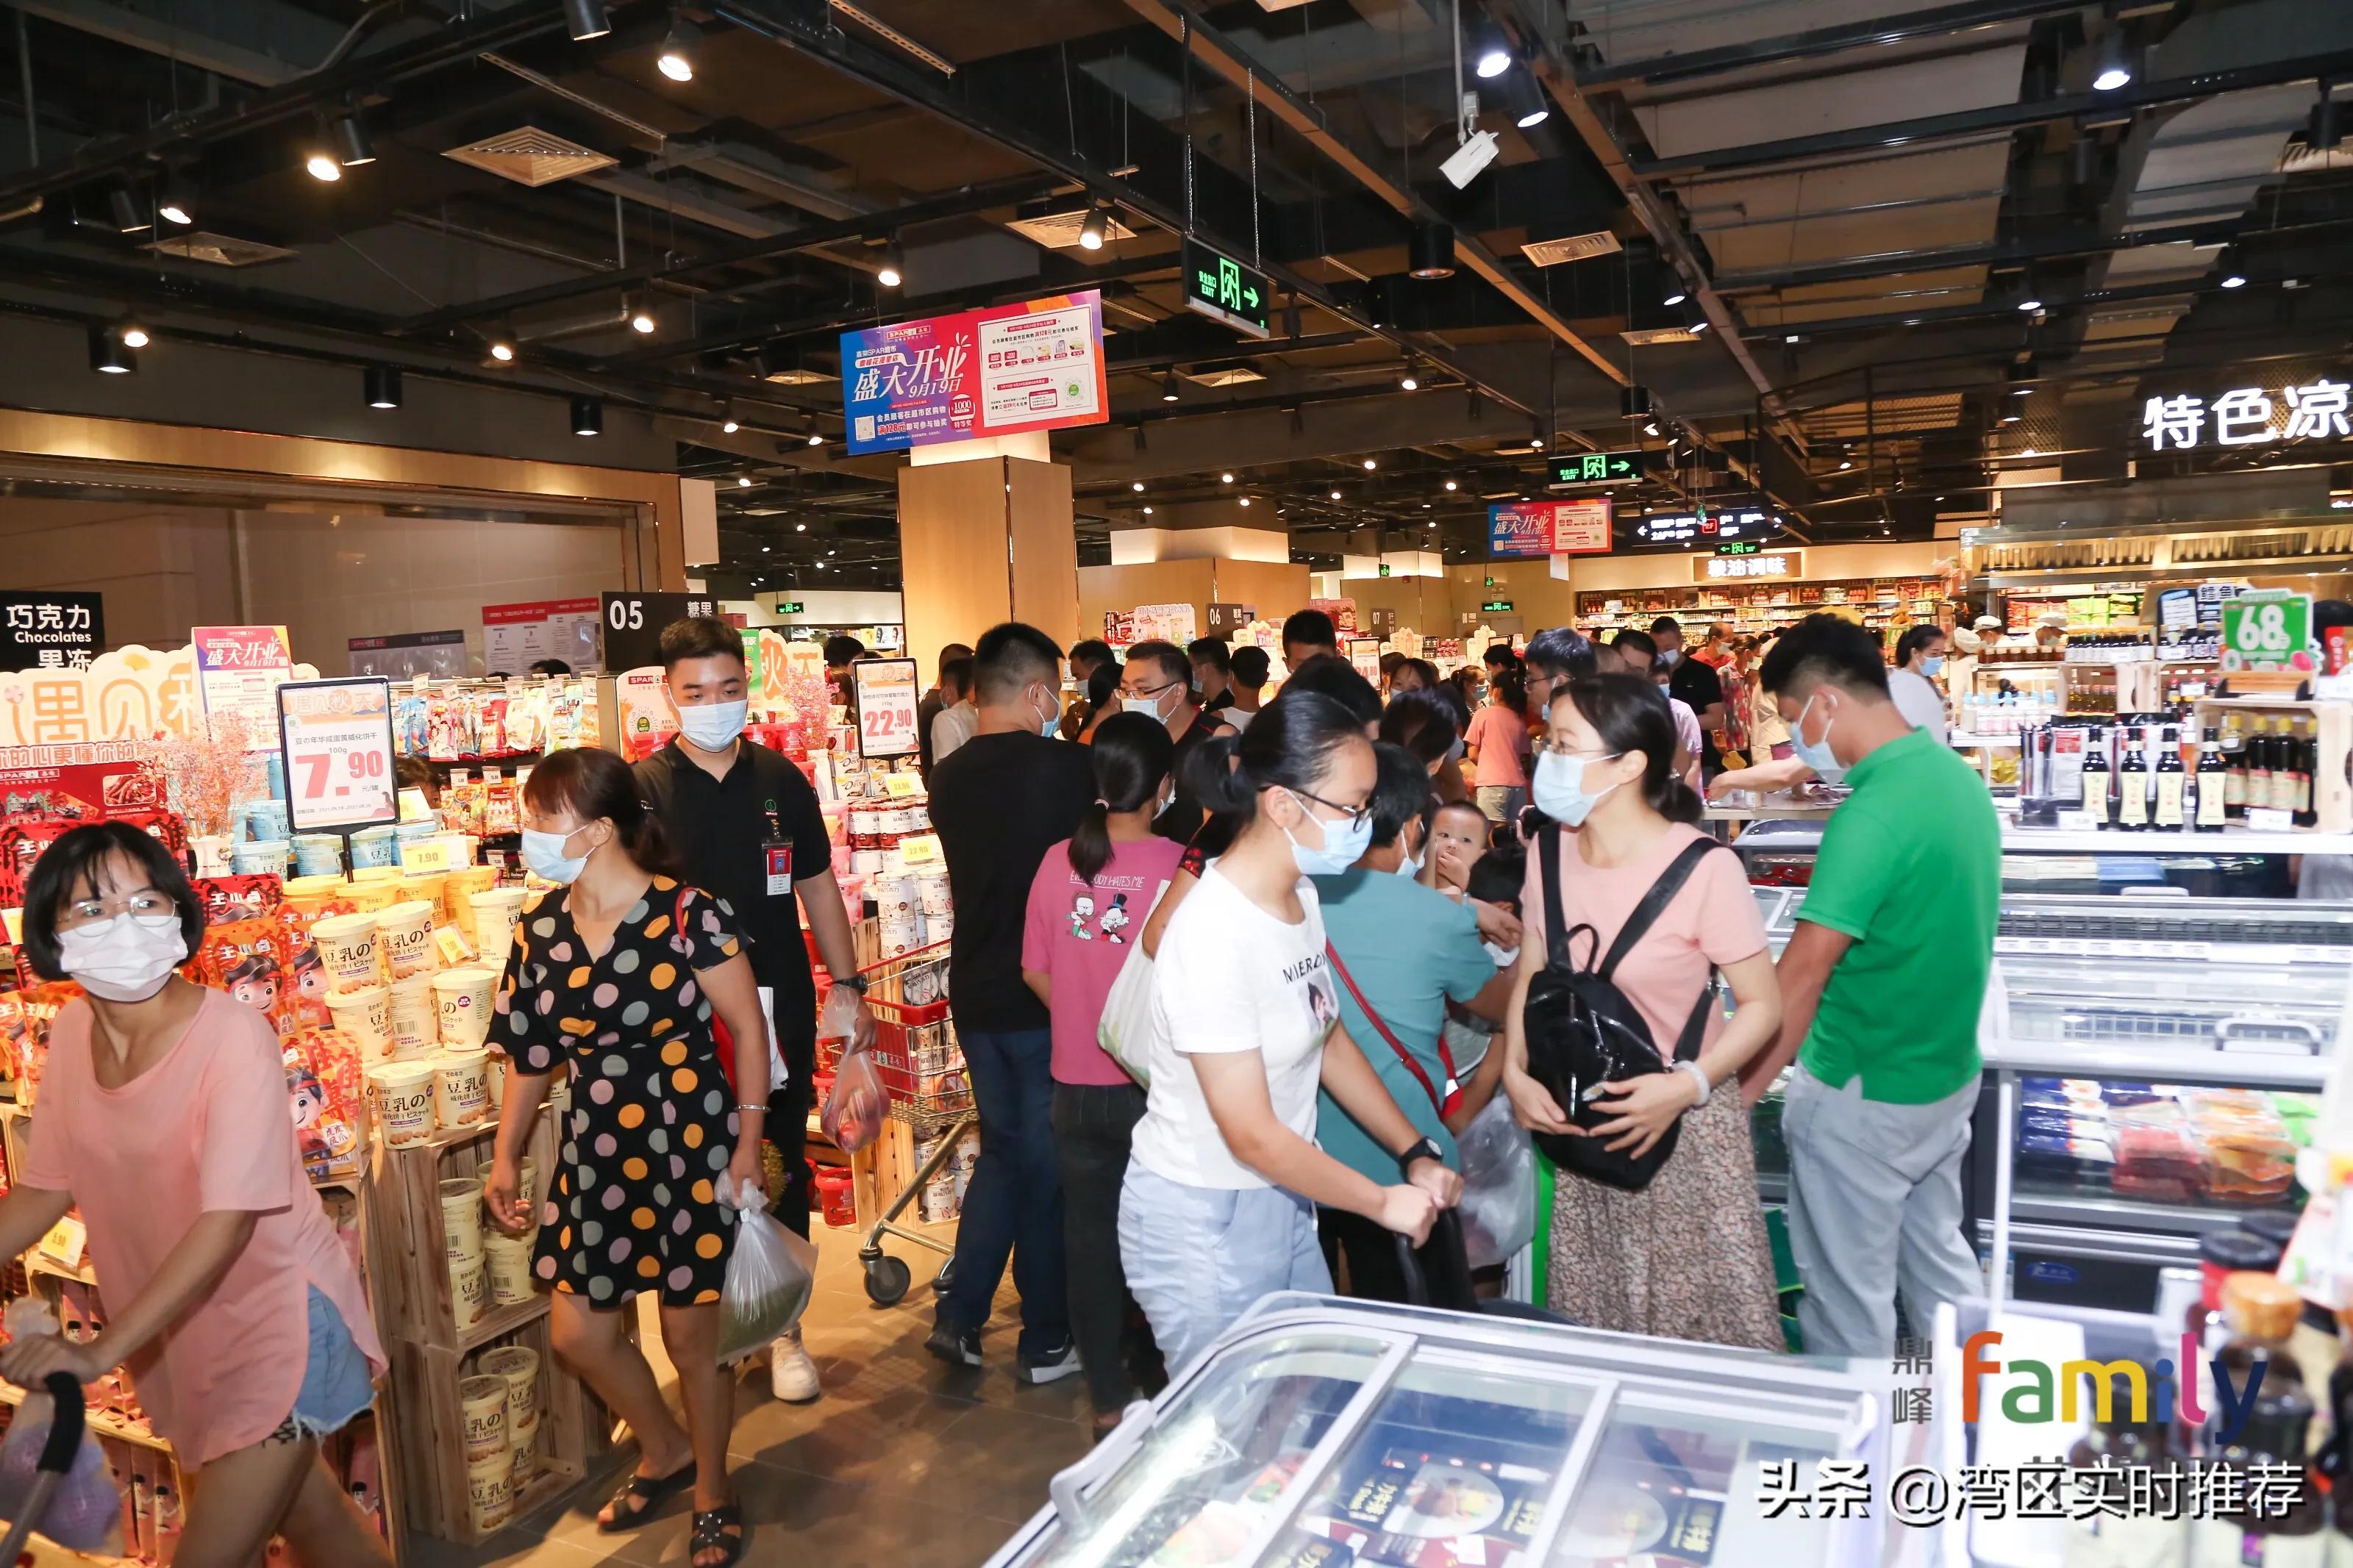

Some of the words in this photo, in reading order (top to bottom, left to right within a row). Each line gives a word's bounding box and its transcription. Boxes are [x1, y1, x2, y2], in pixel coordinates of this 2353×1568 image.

[1202, 284, 1215, 298] EXIT
[851, 342, 968, 403] 盛大开业
[908, 378, 963, 398] 9月19日
[876, 405, 947, 423] 会员顾客在超市区购物
[2142, 379, 2352, 451] 特色凉
[877, 418, 948, 435] 满128元即可参与抽奖
[1493, 511, 1551, 535] 盛大开业
[6, 603, 90, 630] 巧克力
[610, 600, 643, 630] 05
[687, 601, 713, 618] 糖果
[1209, 608, 1221, 625] 06
[1372, 612, 1381, 625] 07
[15, 631, 92, 643] Chocolates
[2236, 604, 2285, 651] 68
[38, 648, 92, 672] 果冻
[205, 638, 279, 666] 盛大开业
[864, 708, 913, 737] 22.90
[0, 742, 149, 767] 的心更懂你的
[295, 750, 384, 799] 7.90
[417, 851, 439, 865] 7.90
[1108, 876, 1131, 888] HATES
[1130, 876, 1146, 888] ME
[210, 890, 262, 906] 王小卤
[219, 938, 271, 960] 王小卤
[382, 930, 424, 949] 豆乳の
[324, 943, 371, 963] 豆乳の
[446, 1073, 488, 1094] 豆乳の
[379, 1094, 425, 1112] 豆乳の
[326, 1125, 344, 1137] 虎皮
[329, 1132, 349, 1145] 凤爪
[463, 1411, 501, 1433] 乳の
[471, 1476, 513, 1500] 豆乳の
